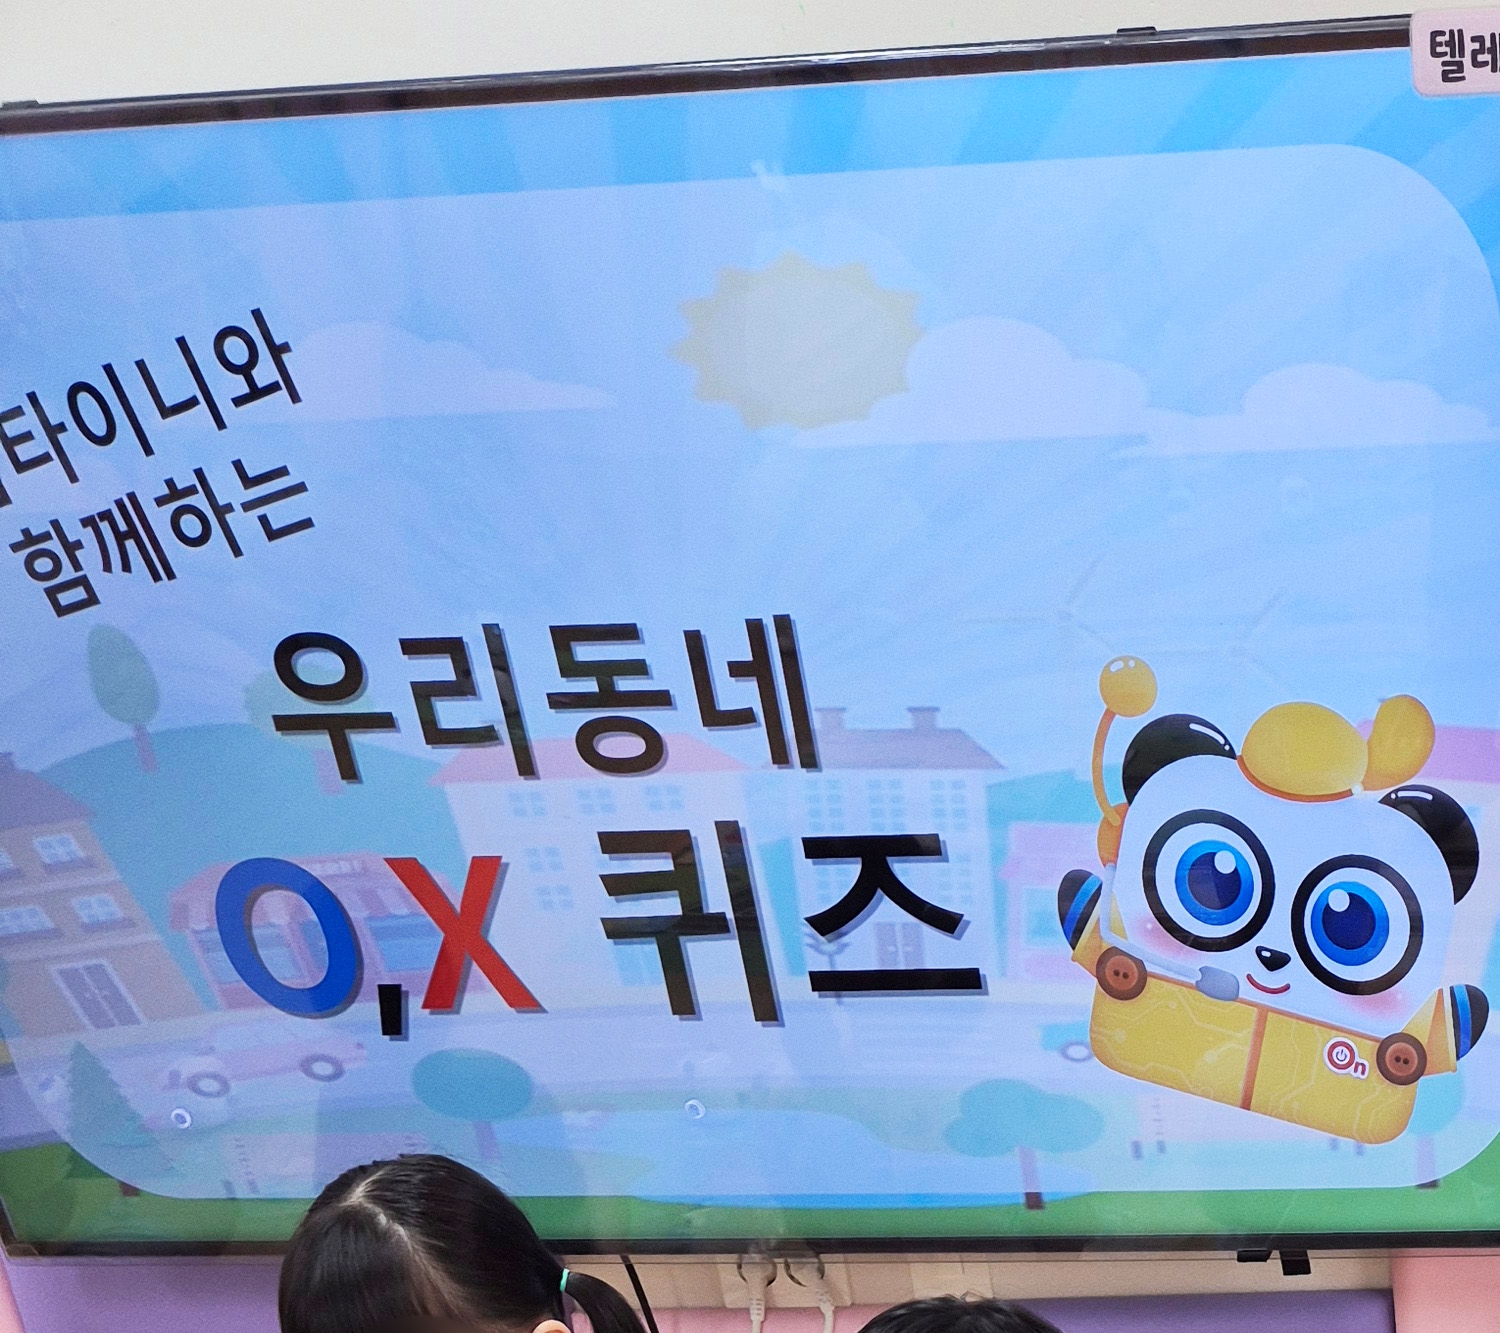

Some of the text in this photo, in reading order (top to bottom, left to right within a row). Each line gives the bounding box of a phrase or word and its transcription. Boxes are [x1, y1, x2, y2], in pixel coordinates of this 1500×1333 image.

[0, 307, 303, 508] 타이니와
[9, 458, 315, 618] 함께하는
[272, 614, 818, 782] 우리동네
[598, 820, 984, 1024] 퀴즈
